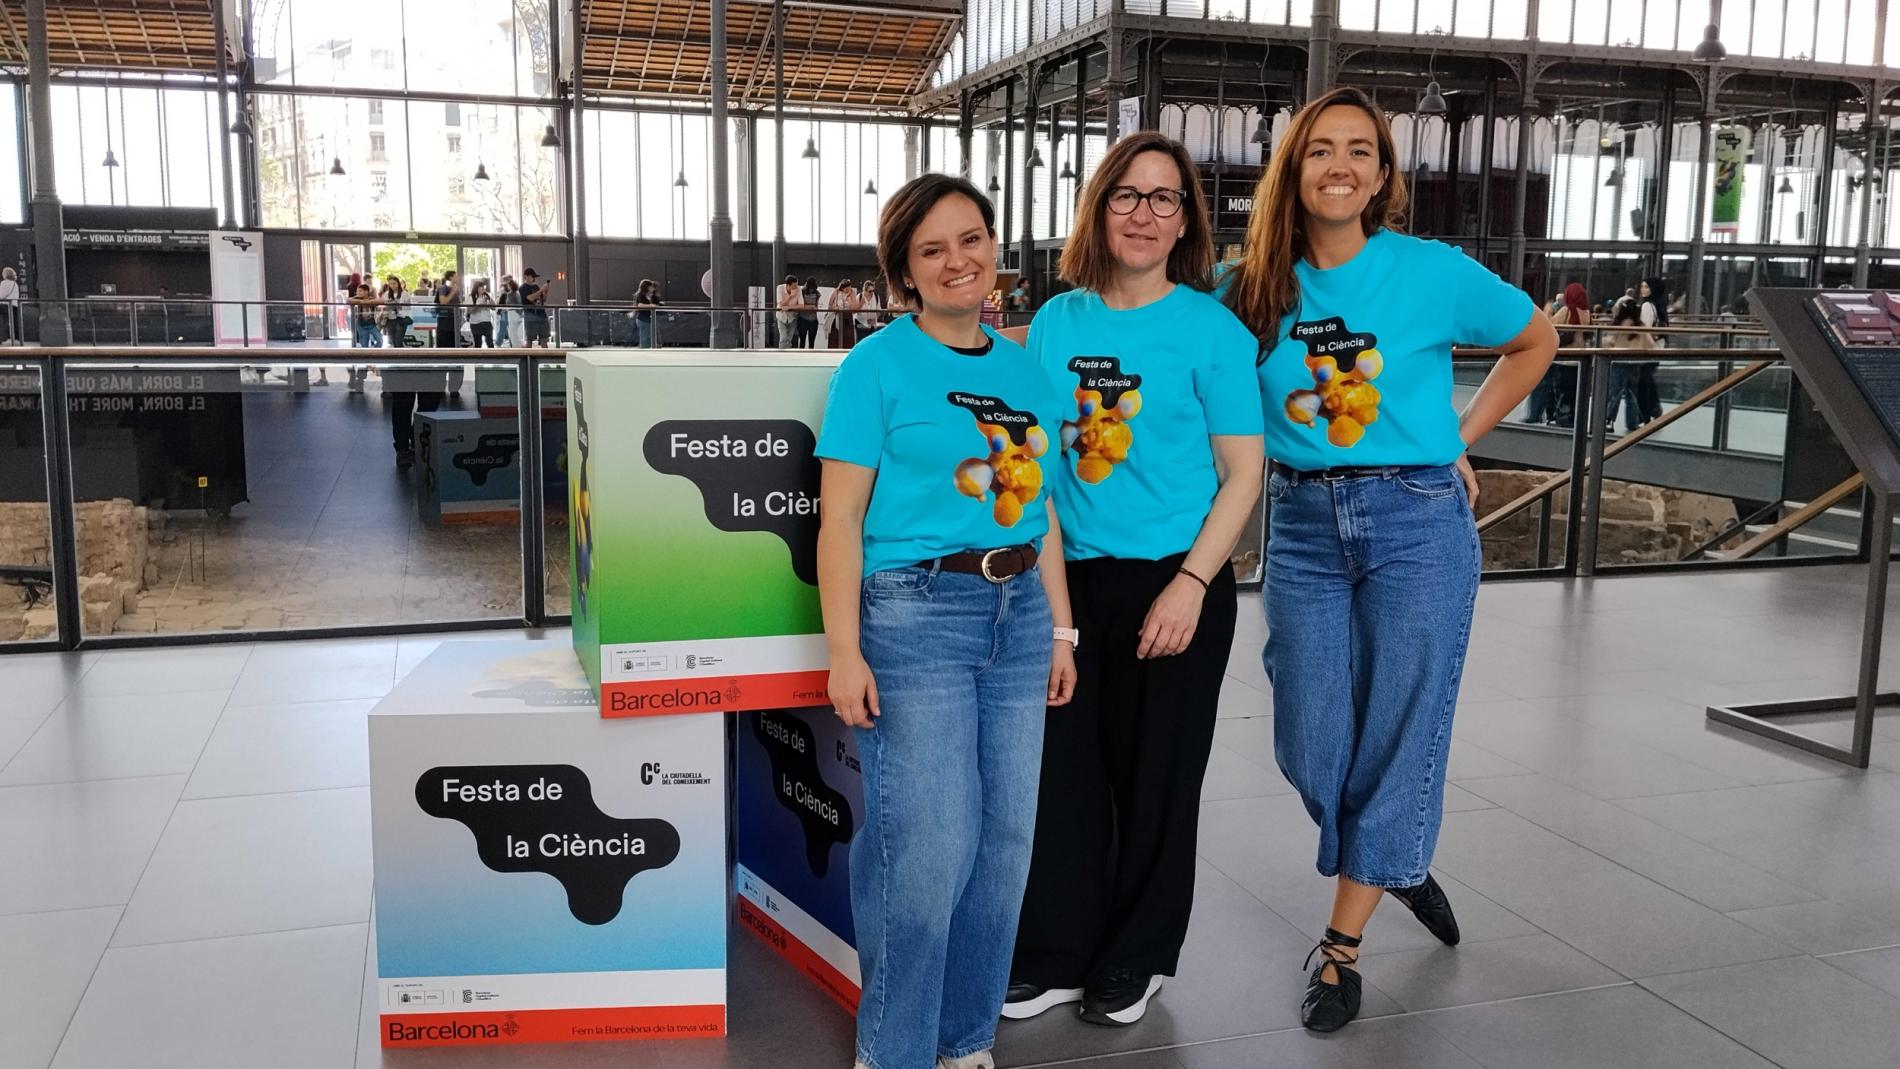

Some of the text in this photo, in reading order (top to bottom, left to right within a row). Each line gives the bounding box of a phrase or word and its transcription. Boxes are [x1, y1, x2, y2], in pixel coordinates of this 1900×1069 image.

[63, 233, 81, 242] ACIÓ
[90, 234, 115, 243] VENDA
[117, 235, 162, 244] D'ENTRADES
[1296, 322, 1337, 335] Festa de
[1317, 337, 1365, 353] la Ciència
[1074, 359, 1112, 369] Festa de
[1087, 377, 1131, 387] la Ciència
[955, 395, 981, 406] Festa
[983, 412, 1028, 423] la Ciència
[670, 432, 789, 458] Festa de
[733, 492, 756, 517] la
[611, 688, 721, 712] Barcelona
[792, 690, 814, 700] Fem
[760, 711, 805, 753] Festa de
[442, 777, 563, 803] Festa de
[783, 773, 839, 826] la Ciència
[507, 832, 646, 858] la Ciència
[389, 1020, 499, 1041] Barcelona
[571, 1022, 718, 1035] Fem la Barcelona de la teva vida
